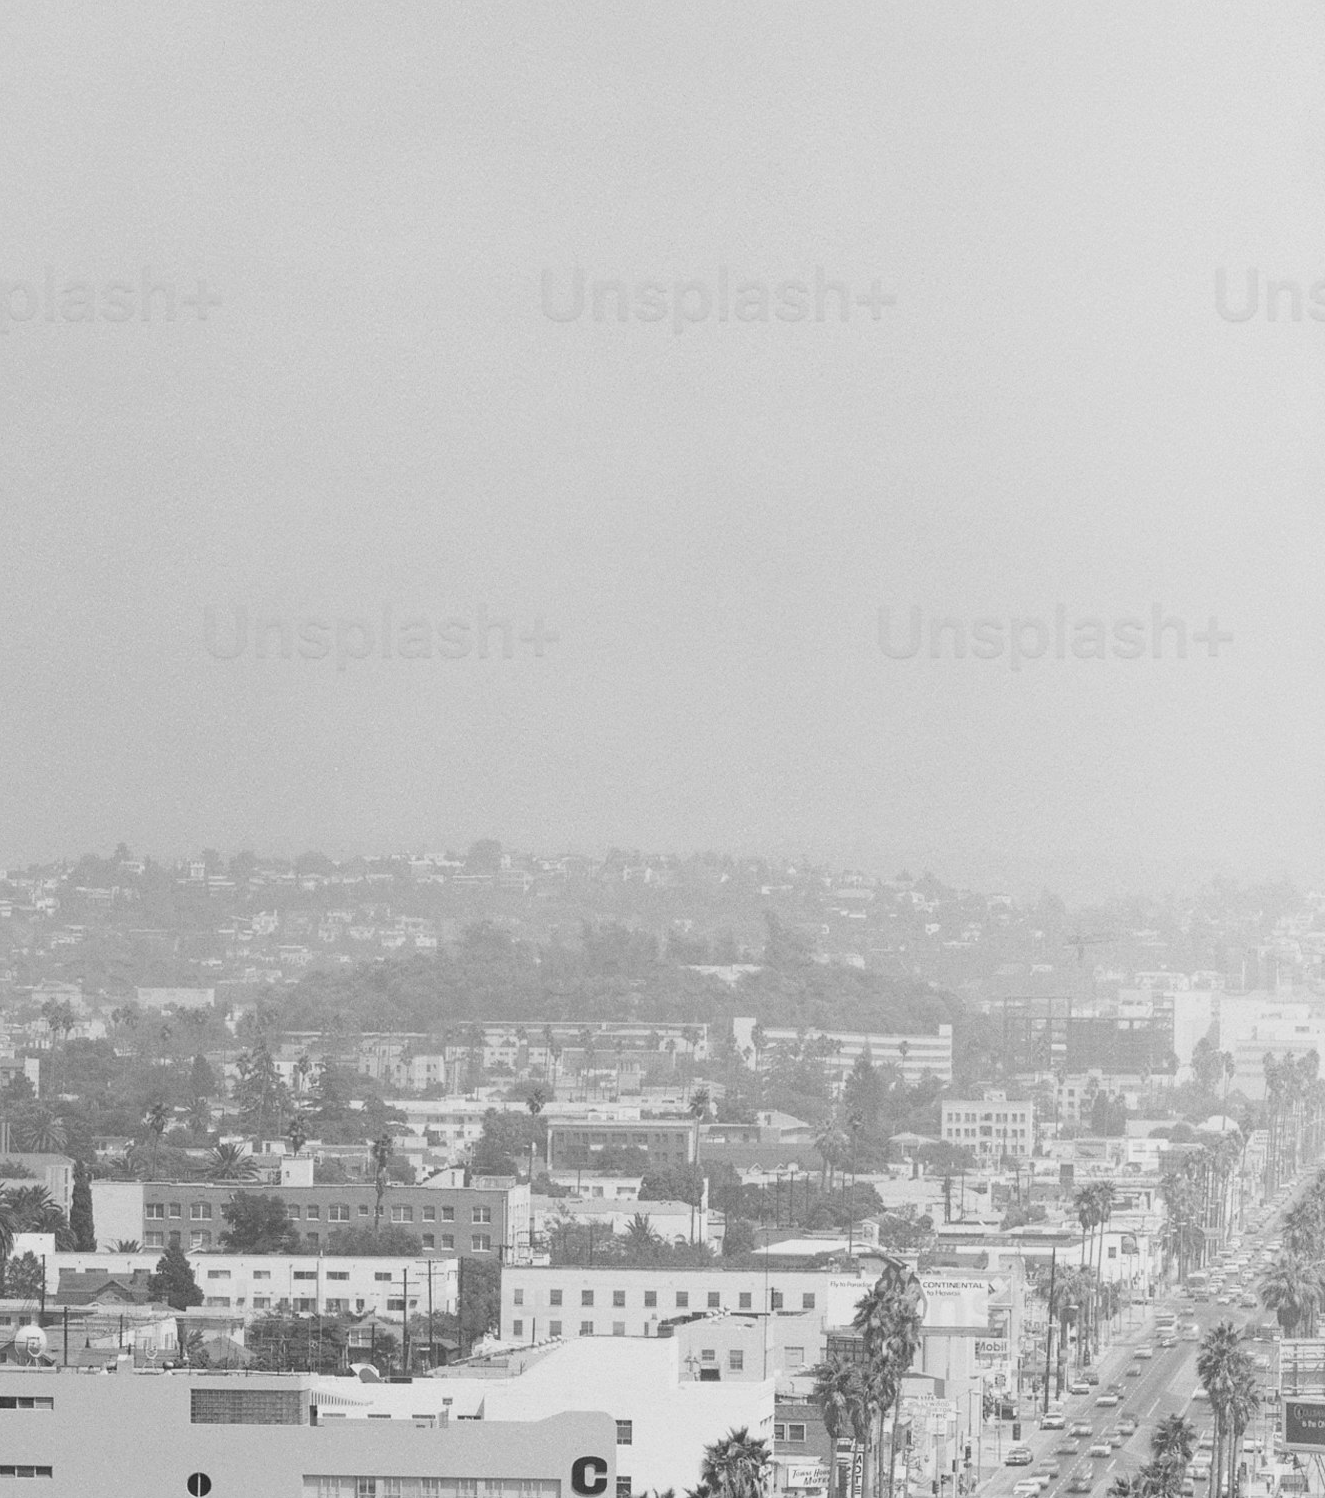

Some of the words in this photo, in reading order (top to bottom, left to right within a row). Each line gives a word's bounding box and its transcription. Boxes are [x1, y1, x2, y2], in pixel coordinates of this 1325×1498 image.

[922, 1281, 984, 1289] CONTINENTAL
[980, 1342, 1007, 1352] Mobil
[813, 1468, 830, 1477] Hou
